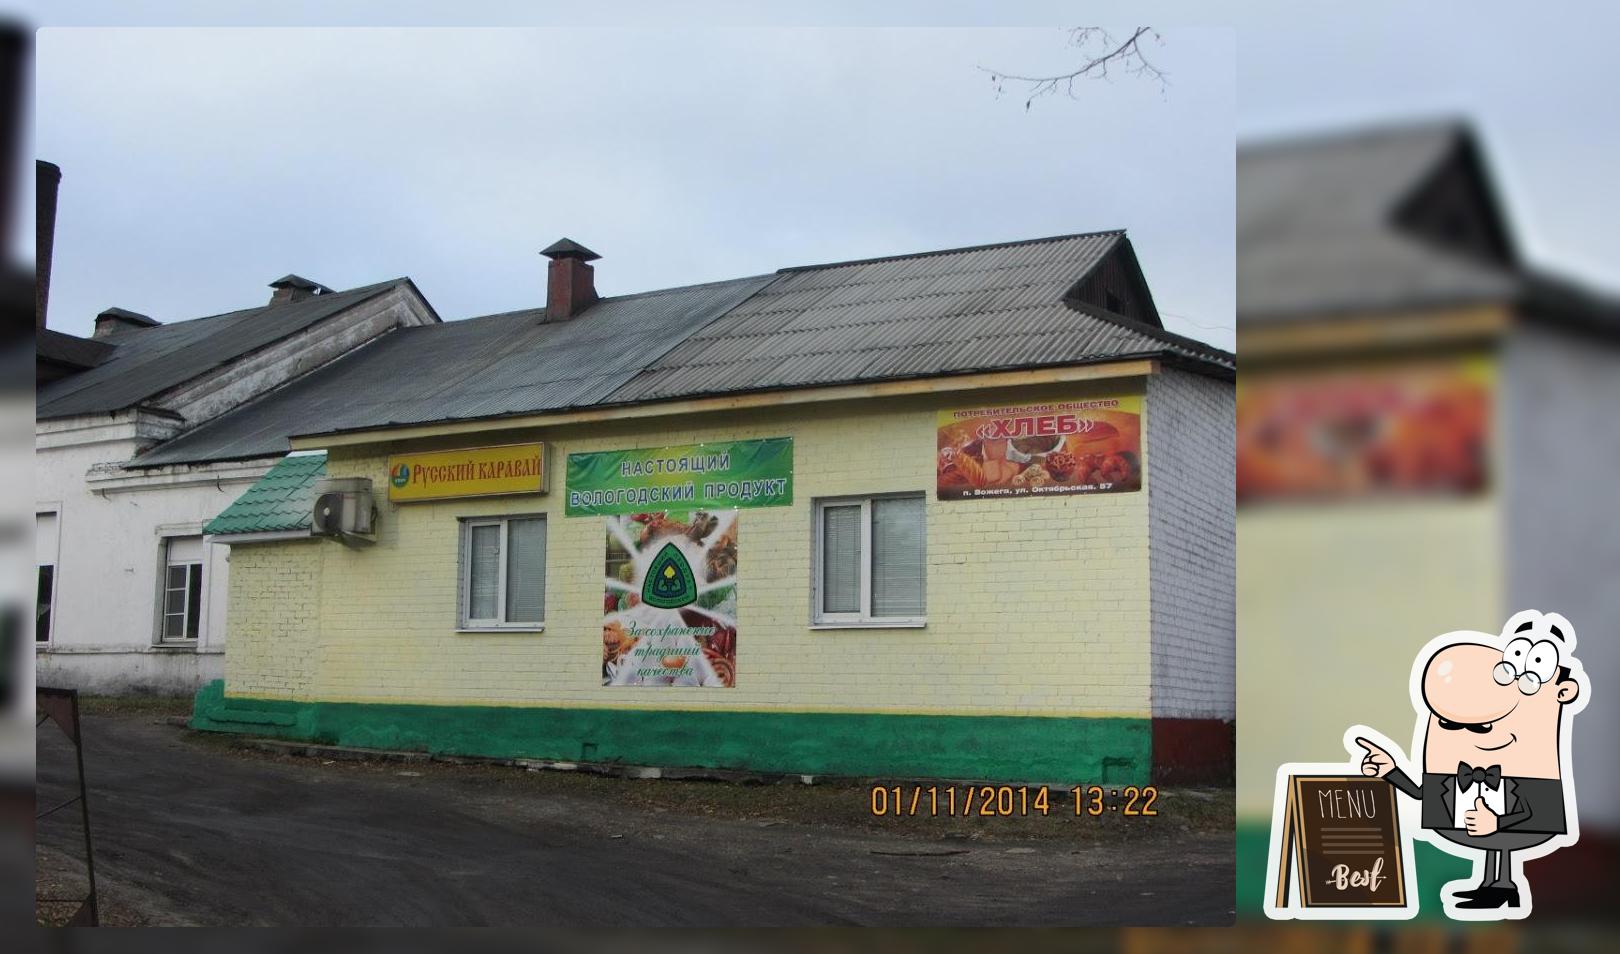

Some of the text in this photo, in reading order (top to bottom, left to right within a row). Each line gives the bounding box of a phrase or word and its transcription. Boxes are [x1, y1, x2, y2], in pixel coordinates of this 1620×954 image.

[953, 400, 1119, 417] ПОТРЕБИТЕЛЬСКОЕ ОБЩЕСТВО
[975, 414, 1095, 440] «ХЛЕБ»
[621, 450, 731, 477] НАСТОЯЩИЙ
[570, 478, 787, 507] ВОЛОГОДСКИЙ ПРОДУКТ
[1015, 487, 1029, 495] ул.
[622, 620, 641, 637] За
[636, 663, 694, 677] качества
